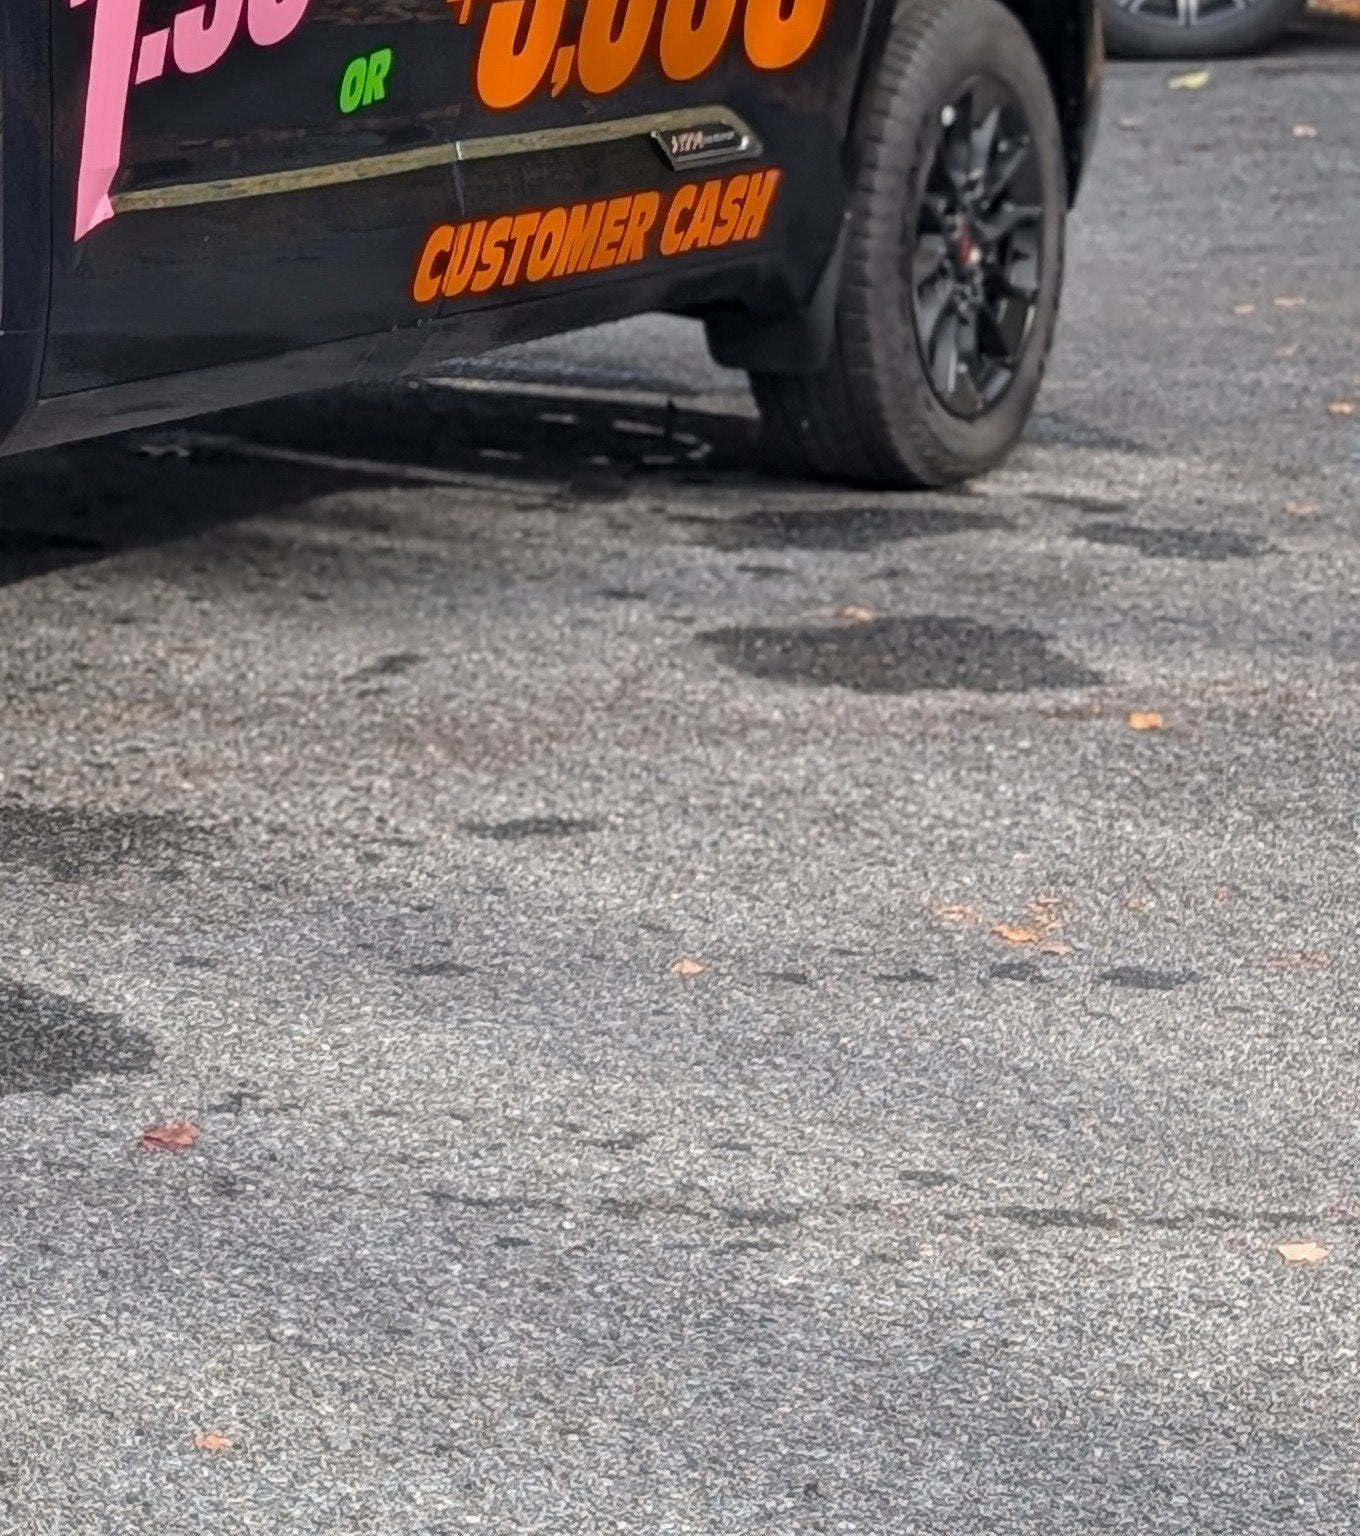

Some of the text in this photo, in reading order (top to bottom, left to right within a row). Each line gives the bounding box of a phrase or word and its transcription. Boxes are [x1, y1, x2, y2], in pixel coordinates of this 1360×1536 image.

[339, 48, 392, 114] OR
[413, 169, 781, 303] CUSTOMER CASH
